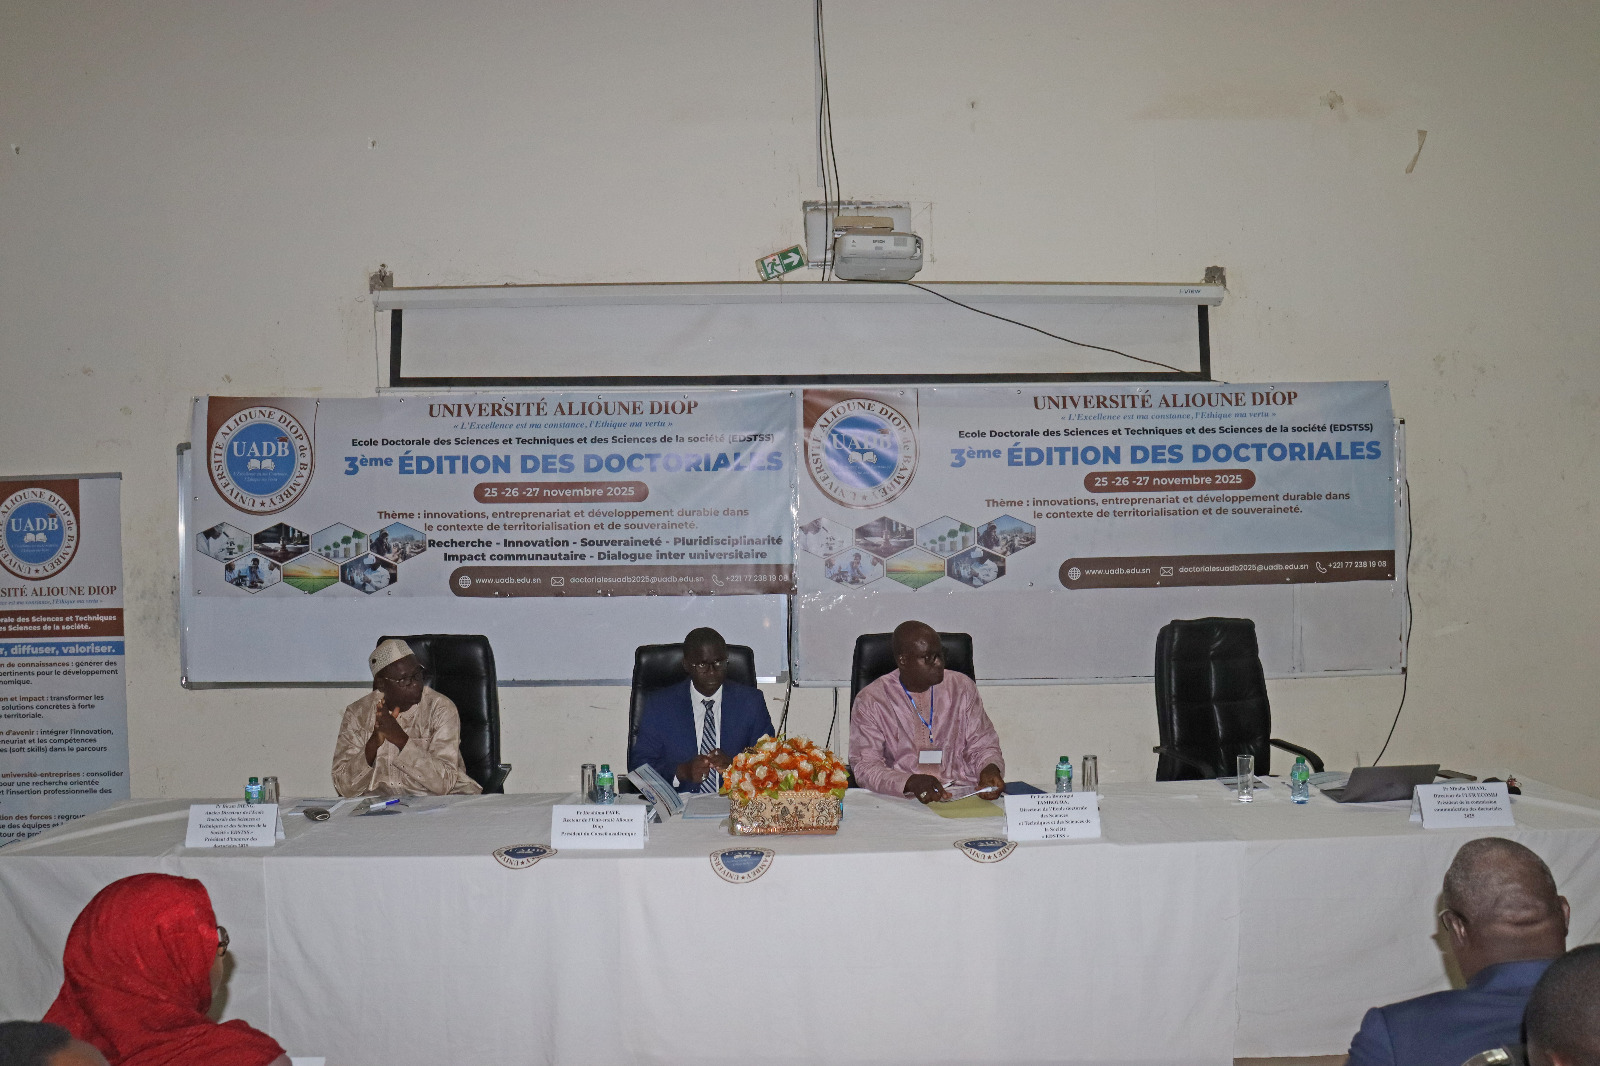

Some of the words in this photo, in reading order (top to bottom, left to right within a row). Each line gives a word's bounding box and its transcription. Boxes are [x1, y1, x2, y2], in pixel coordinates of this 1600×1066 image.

[1033, 390, 1152, 410] UNIVERSITÉ
[1158, 392, 1246, 408] ALIOUNE
[1251, 391, 1298, 406] DIOP
[428, 398, 548, 418] UNIVERSITÉ
[554, 400, 644, 416] ALIOUNE
[649, 400, 699, 415] DIOP
[221, 409, 276, 440] ALIOUNE
[278, 414, 304, 441] DIOP
[460, 422, 513, 430] L'Excellence
[544, 420, 588, 430] constance,
[958, 430, 987, 438] Ecole
[989, 429, 1040, 438] Doctorale
[1042, 428, 1061, 437] des
[1063, 428, 1110, 437] Sciences
[1124, 426, 1183, 436] Techniques
[1185, 426, 1196, 434] et
[1198, 426, 1216, 434] des
[1218, 425, 1263, 434] Sciences
[1265, 424, 1278, 434] de
[1280, 424, 1289, 433] la
[1291, 424, 1328, 433] société
[1329, 423, 1374, 434] (EDSTSS)
[351, 438, 379, 447] Ecole
[381, 437, 431, 446] Doctorale
[433, 437, 452, 446] des
[454, 436, 500, 446] Sciences
[516, 436, 575, 447] Techniques
[577, 436, 588, 444] et
[590, 435, 609, 444] des
[611, 435, 658, 444] Sciences
[660, 435, 673, 444] de
[675, 435, 685, 444] la
[688, 434, 726, 444] société
[728, 433, 775, 444] (EDSTSS)
[233, 441, 290, 457] UADB
[950, 446, 1002, 468] 3ème
[1007, 441, 1122, 467] ÉDITION
[1130, 444, 1184, 464] DES
[1192, 440, 1382, 464] DOCTORIALES
[344, 455, 394, 476] 3ème
[398, 450, 512, 475] ÉDITION
[520, 454, 576, 474] DES
[583, 451, 784, 474] DOCTORIALES
[214, 442, 256, 508] UNIVERSITE
[1094, 477, 1108, 487] 25
[1111, 476, 1130, 486] -26
[1132, 476, 1150, 486] -27
[1153, 475, 1212, 486] novembre
[1215, 474, 1243, 484] 2025
[268, 462, 308, 508] BAMBEY
[484, 488, 498, 498] 25
[500, 487, 520, 498] -26
[522, 487, 540, 498] -27
[543, 486, 604, 498] novembre
[606, 486, 636, 496] 2025
[985, 498, 1024, 508] Thème
[1032, 497, 1099, 507] innovations,
[1101, 496, 1180, 508] entreprenariat
[1183, 496, 1194, 504] et
[1196, 493, 1280, 504] développement
[1282, 492, 1323, 501] durable
[1325, 491, 1350, 500] dans
[377, 510, 415, 520] Thème
[423, 510, 490, 520] innovations,
[491, 509, 572, 521] entreprenariat
[574, 510, 586, 518] et
[588, 508, 675, 520] développement
[676, 508, 720, 517] durable
[722, 508, 750, 516] dans
[1033, 510, 1043, 519] le
[1045, 510, 1094, 519] contexte
[1096, 509, 1110, 518] de
[1113, 507, 1199, 517] territorialisation
[1202, 507, 1213, 516] et
[1215, 506, 1229, 515] de
[1231, 505, 1304, 515] souveraineté.
[10, 518, 58, 532] UADB
[424, 523, 434, 532] le
[436, 523, 484, 532] contexte
[488, 522, 501, 532] de
[503, 521, 592, 532] territorialisation
[593, 522, 605, 530] et
[608, 521, 622, 530] de
[624, 520, 698, 530] souveraineté.
[428, 538, 493, 548] Recherche
[503, 537, 570, 548] Innovation
[580, 536, 662, 547] Souveraineté
[673, 534, 784, 548] Pluridisciplinarité
[444, 552, 486, 563] Impact
[489, 552, 586, 562] communautaire
[597, 550, 652, 562] Dialogue
[656, 550, 686, 560] inter
[688, 549, 768, 560] universitaire
[1085, 567, 1151, 576] www.uadb.edu.sn
[475, 576, 542, 584] www.uadb.edu.sn
[30, 586, 84, 597] ALIOUNE
[88, 586, 116, 596] DIOP
[75, 614, 116, 622] Techniques
[11, 644, 60, 656] diffuser,
[62, 642, 116, 654] valoriser.
